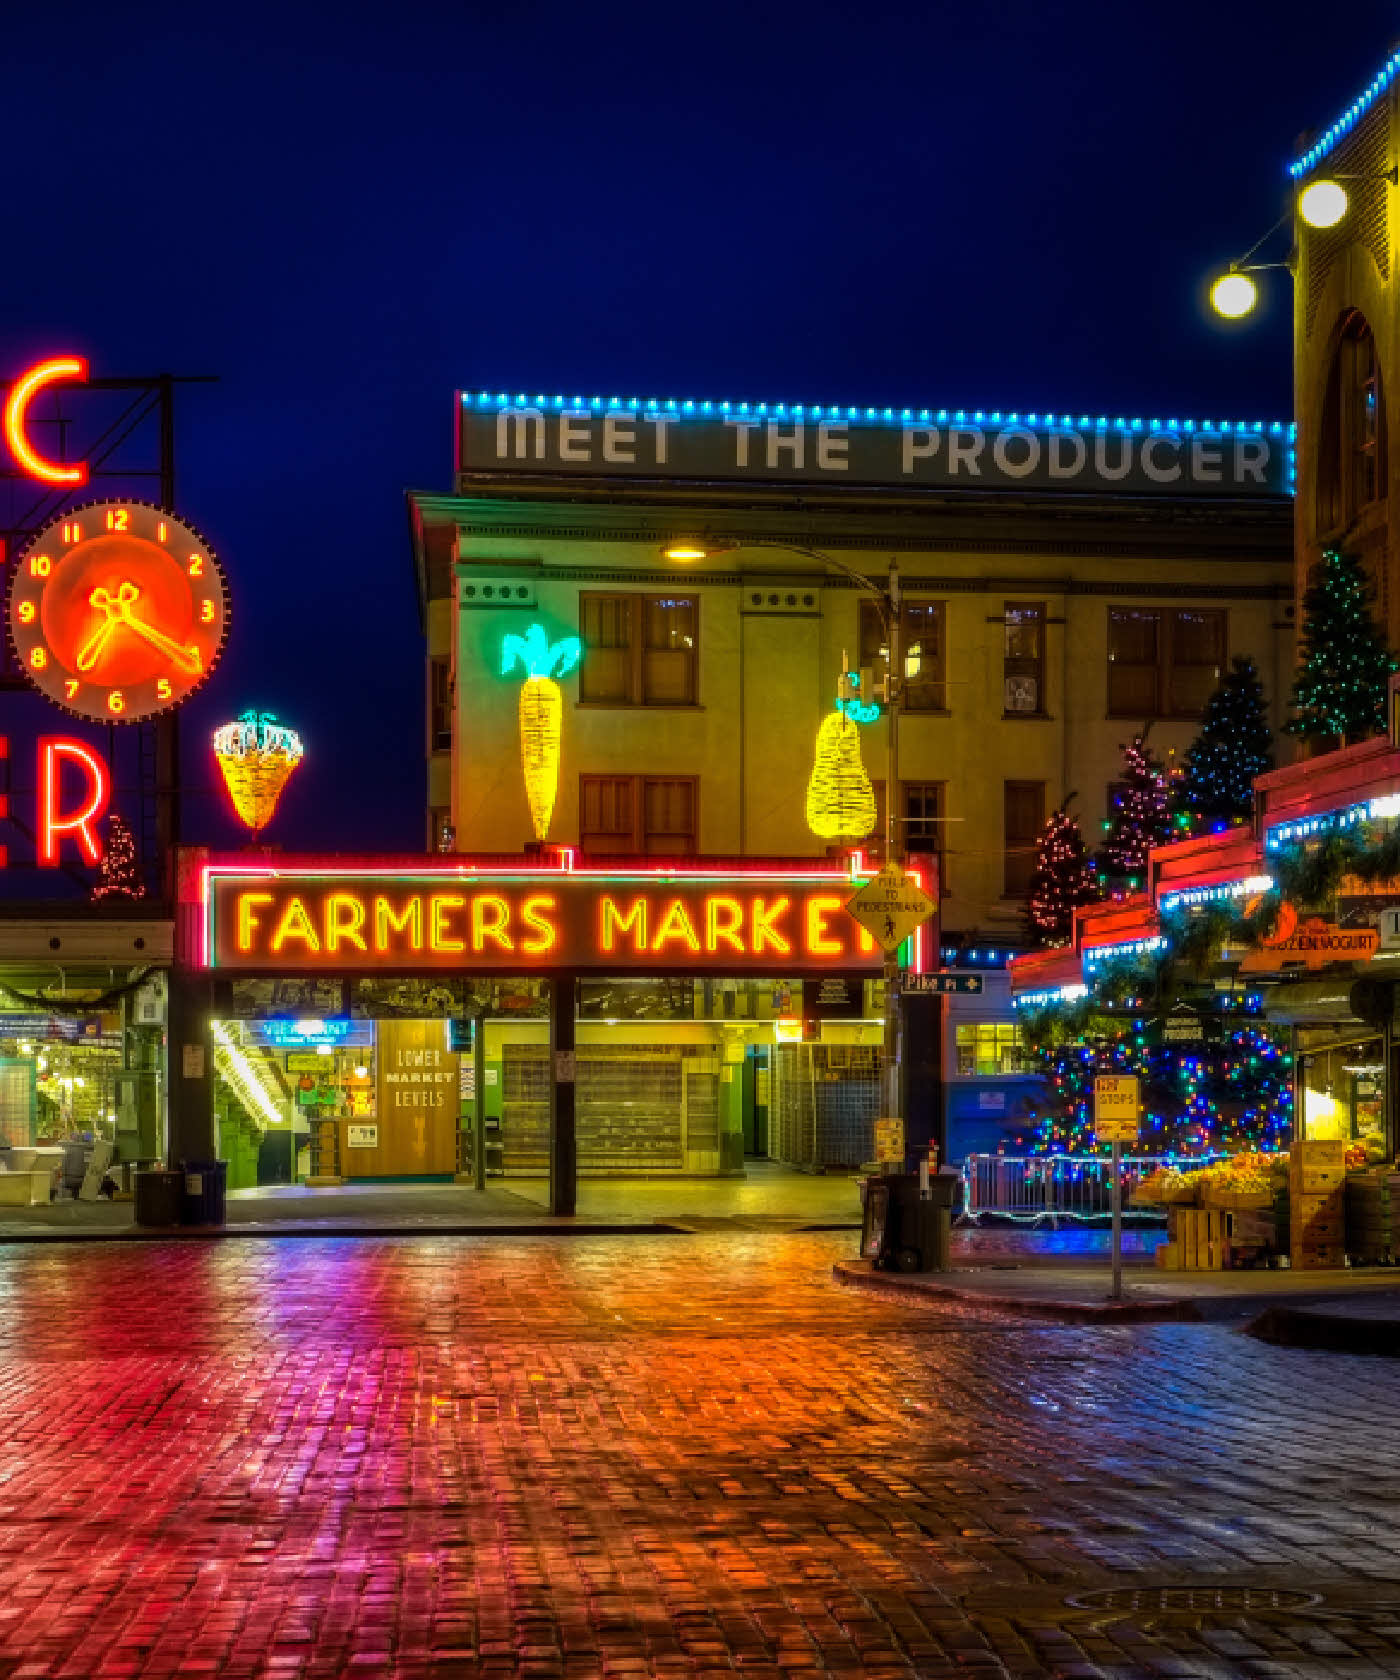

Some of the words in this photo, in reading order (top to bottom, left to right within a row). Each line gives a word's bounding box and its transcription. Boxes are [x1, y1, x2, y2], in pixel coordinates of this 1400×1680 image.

[497, 407, 680, 463] MEET
[724, 415, 849, 470] THE
[902, 421, 1271, 482] PRODUCER
[107, 508, 129, 530] 12
[63, 523, 80, 542] 11
[159, 522, 167, 542] 1
[30, 556, 51, 576] 10
[189, 554, 203, 576] 2
[18, 601, 35, 622] 9
[200, 600, 215, 622] 3
[30, 648, 47, 668] 8
[64, 679, 80, 698] 7
[157, 679, 172, 698] 5
[108, 691, 124, 713] 6
[237, 894, 557, 952] FARMERS
[601, 896, 874, 952] MARKE
[398, 1050, 441, 1067] LOWER
[386, 1072, 455, 1083] MARKET
[395, 1091, 445, 1107] LEVELS
